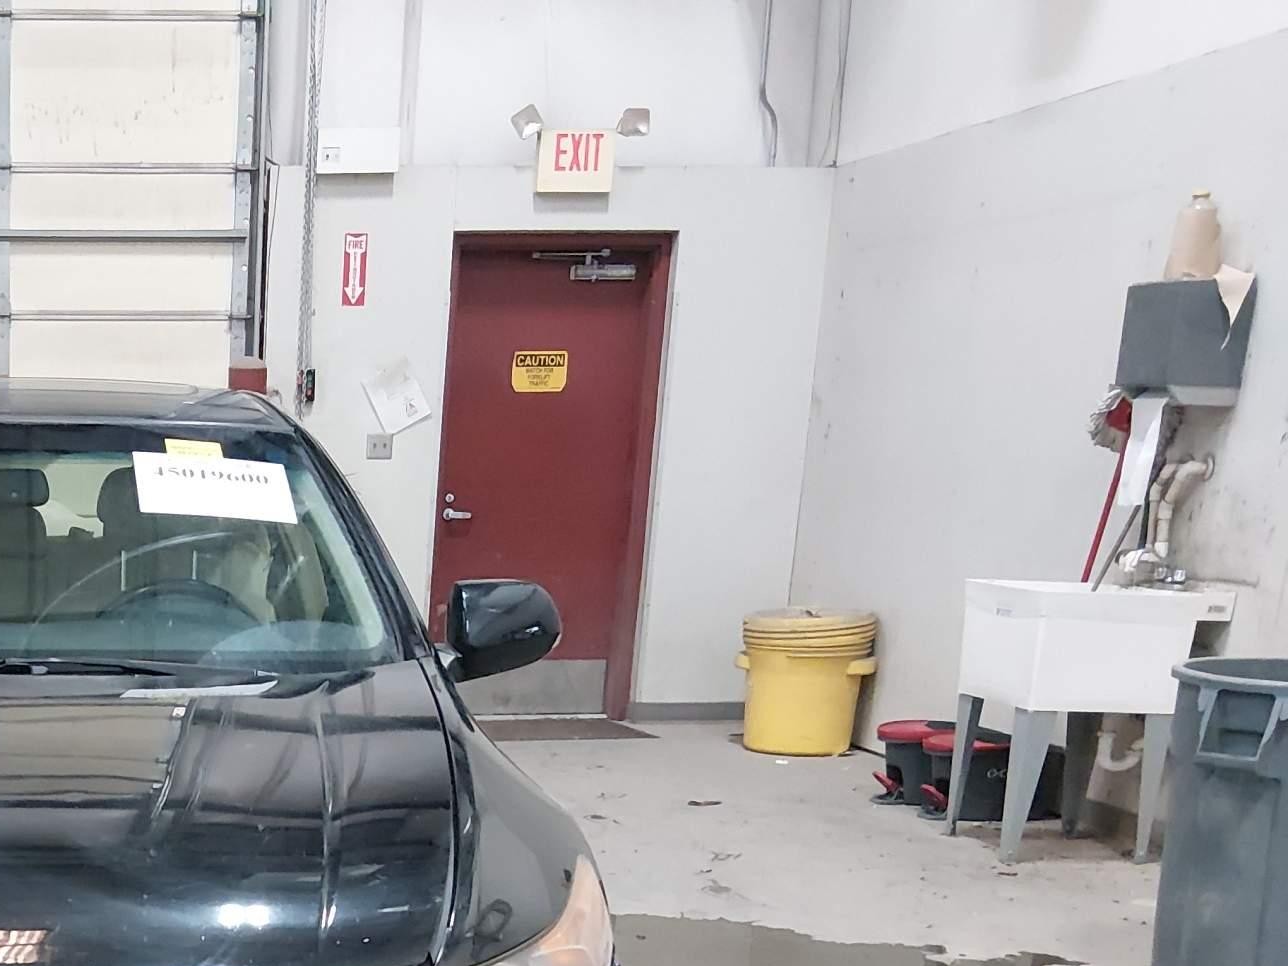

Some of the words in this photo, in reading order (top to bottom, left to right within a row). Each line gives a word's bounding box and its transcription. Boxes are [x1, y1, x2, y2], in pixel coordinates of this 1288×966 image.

[554, 133, 605, 171] EXIT
[348, 240, 364, 249] FIRE
[517, 355, 564, 366] CAUTION
[154, 466, 269, 485] 45019600
